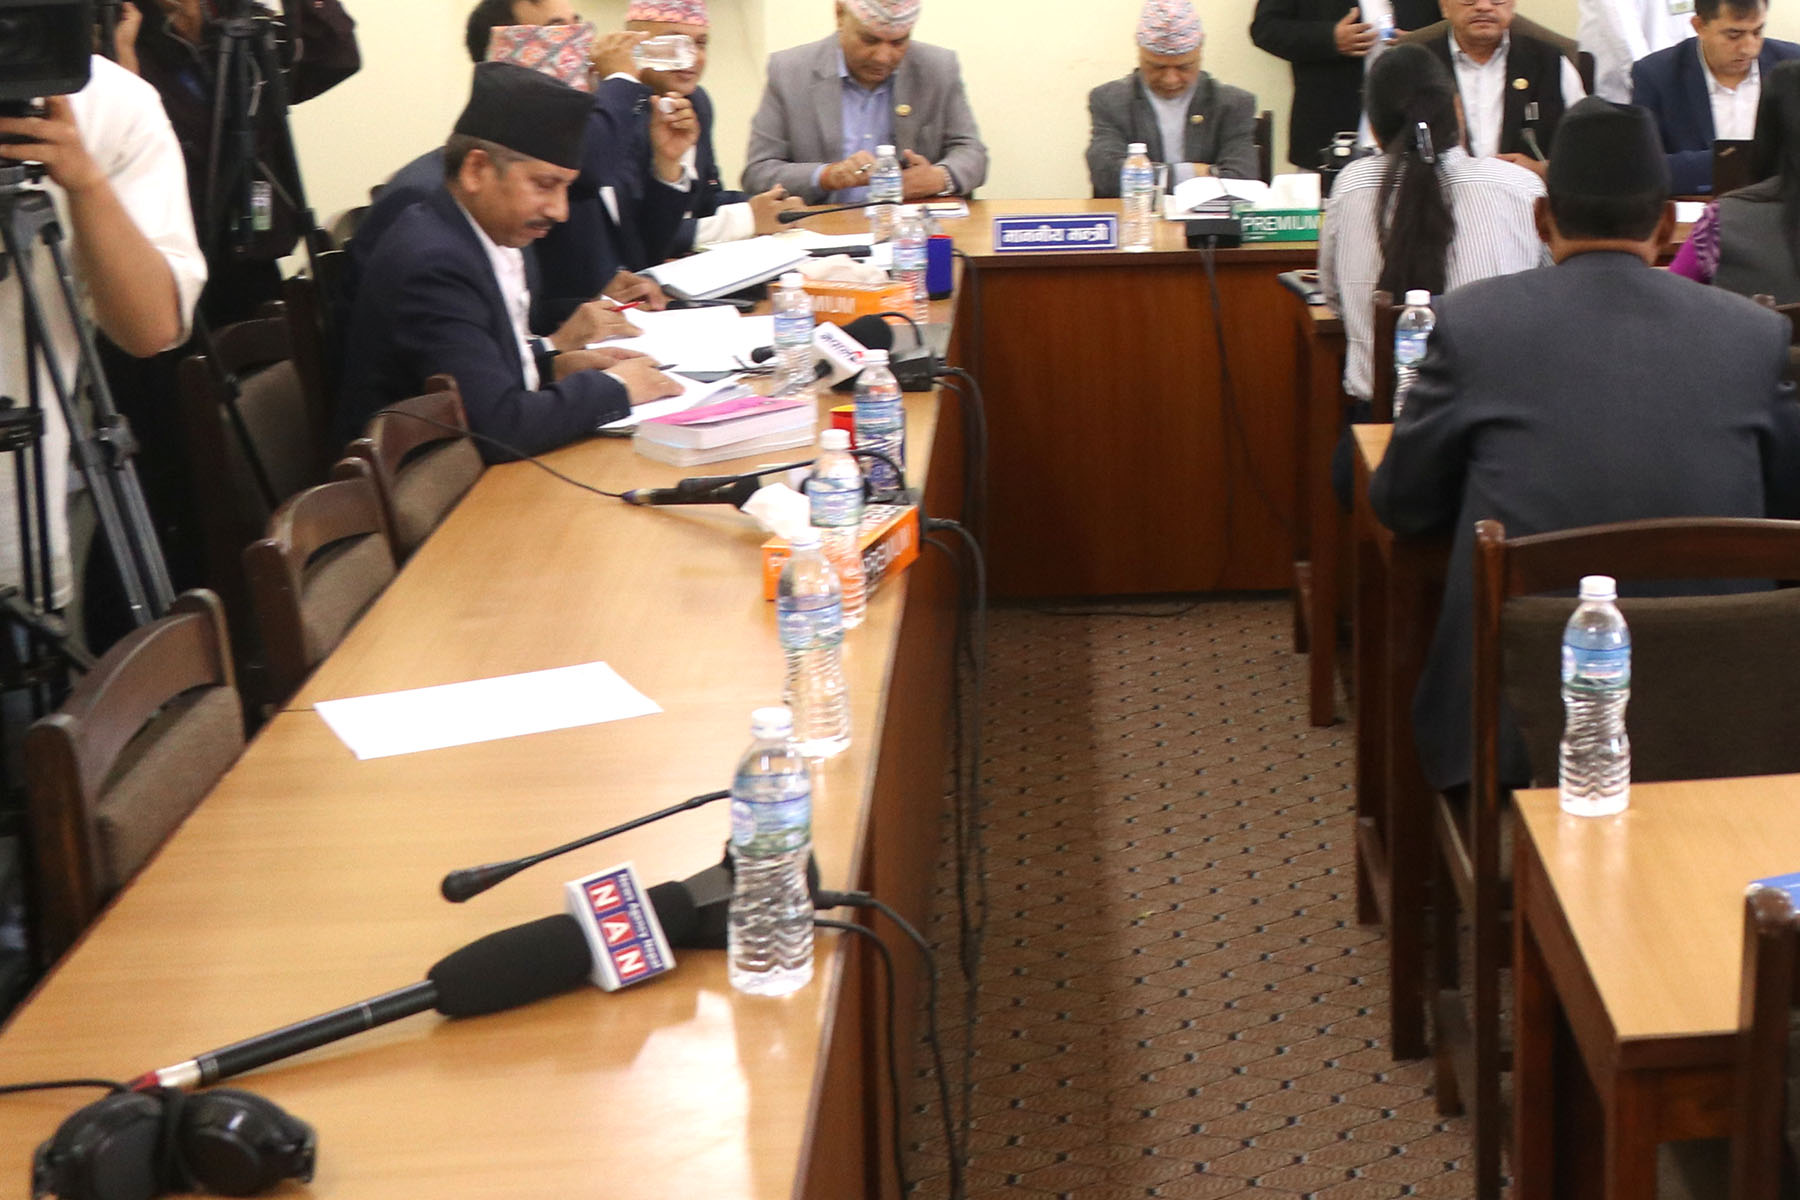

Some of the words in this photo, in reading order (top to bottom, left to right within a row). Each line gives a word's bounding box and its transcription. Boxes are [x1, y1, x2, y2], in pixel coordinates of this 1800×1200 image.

[1241, 215, 1319, 232] PREMIUM
[1001, 225, 1064, 243] माननीय
[588, 882, 646, 974] NAN
